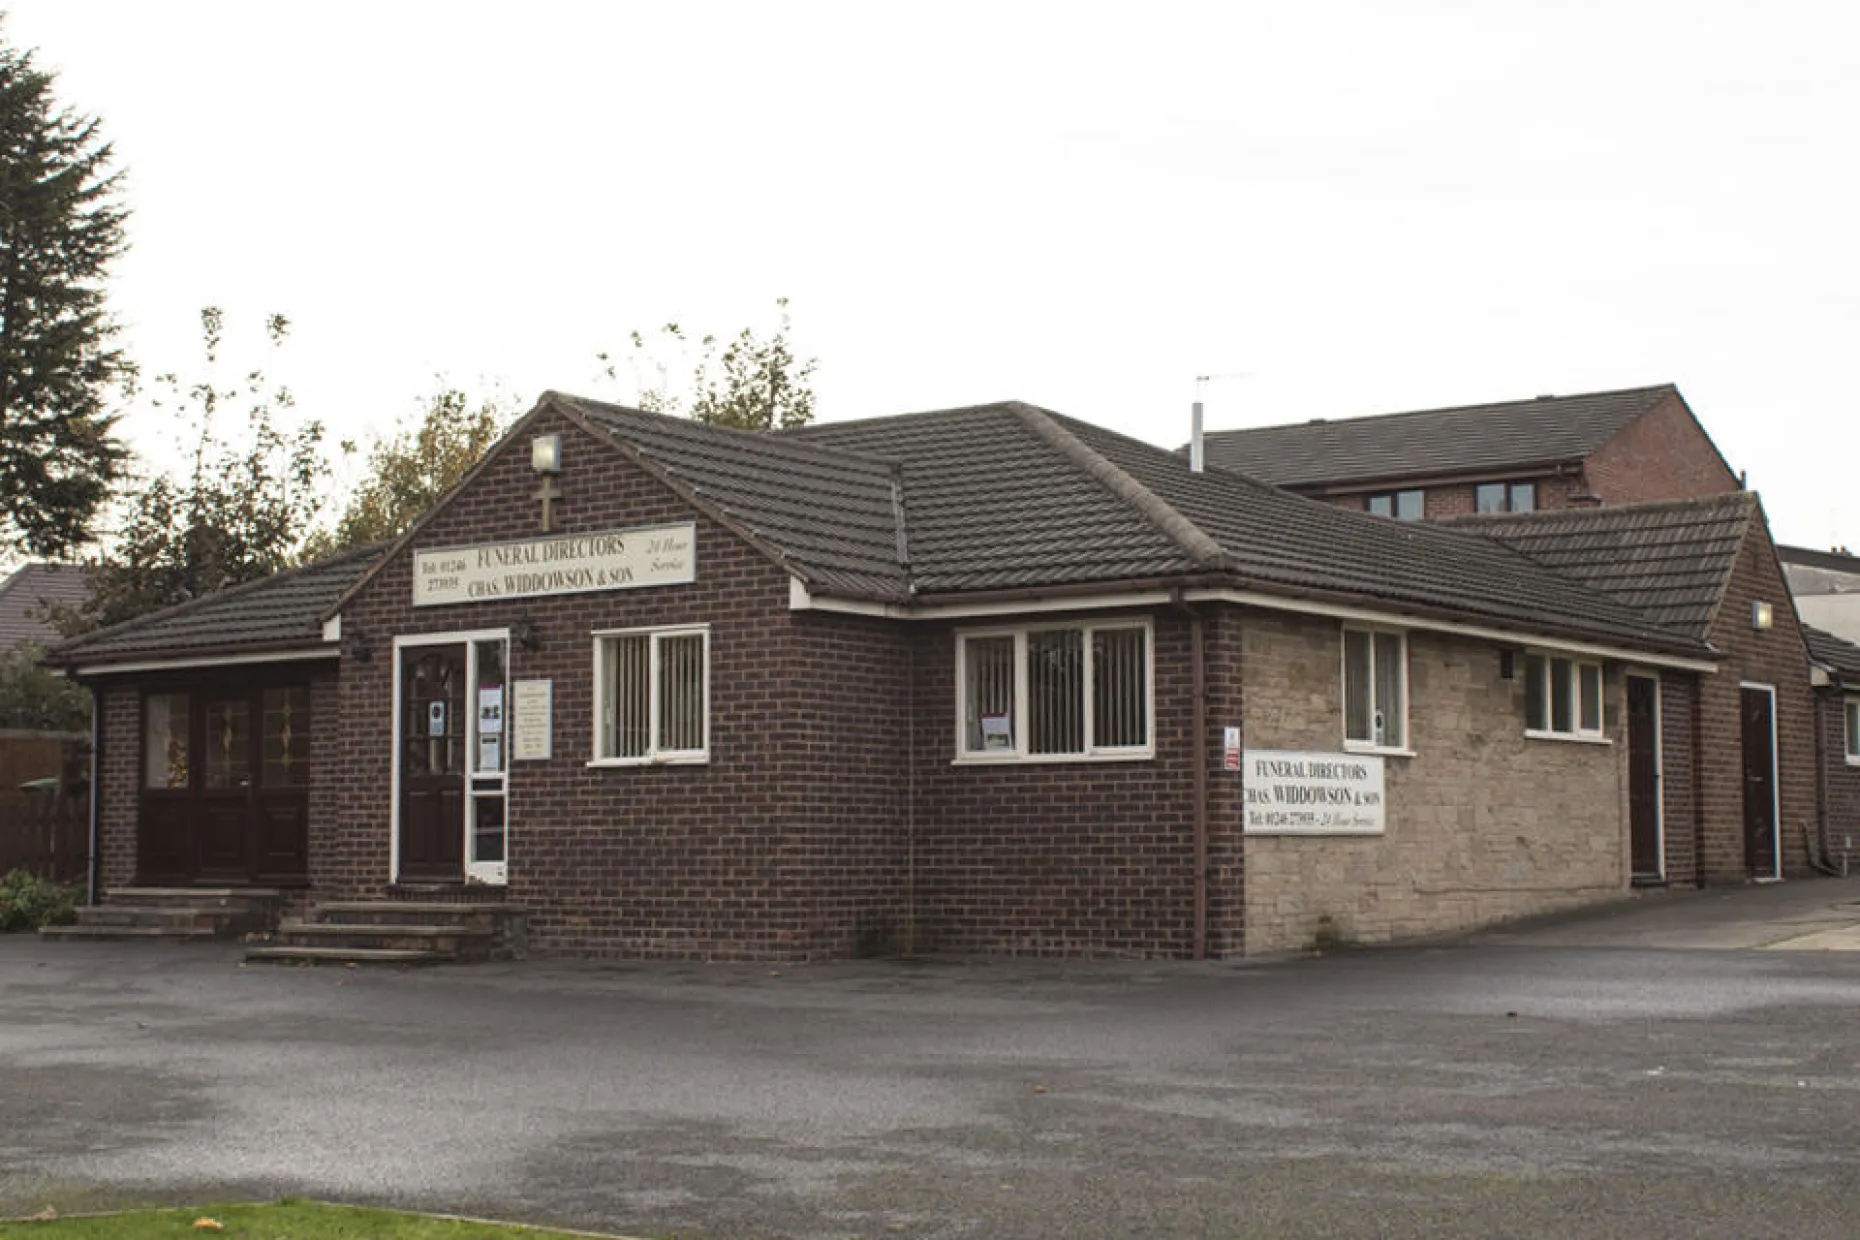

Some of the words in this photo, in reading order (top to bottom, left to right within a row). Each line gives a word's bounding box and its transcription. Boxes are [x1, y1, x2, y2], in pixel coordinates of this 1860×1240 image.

[478, 542, 540, 568] FUNERAL
[543, 535, 624, 562] DIRECTORS
[504, 568, 594, 593] WIDDOWSON
[610, 566, 634, 583] SON
[1256, 760, 1304, 778] FUNERAL
[1309, 762, 1367, 780] DIRECTORS
[1272, 785, 1351, 805] WIDDOWSON
